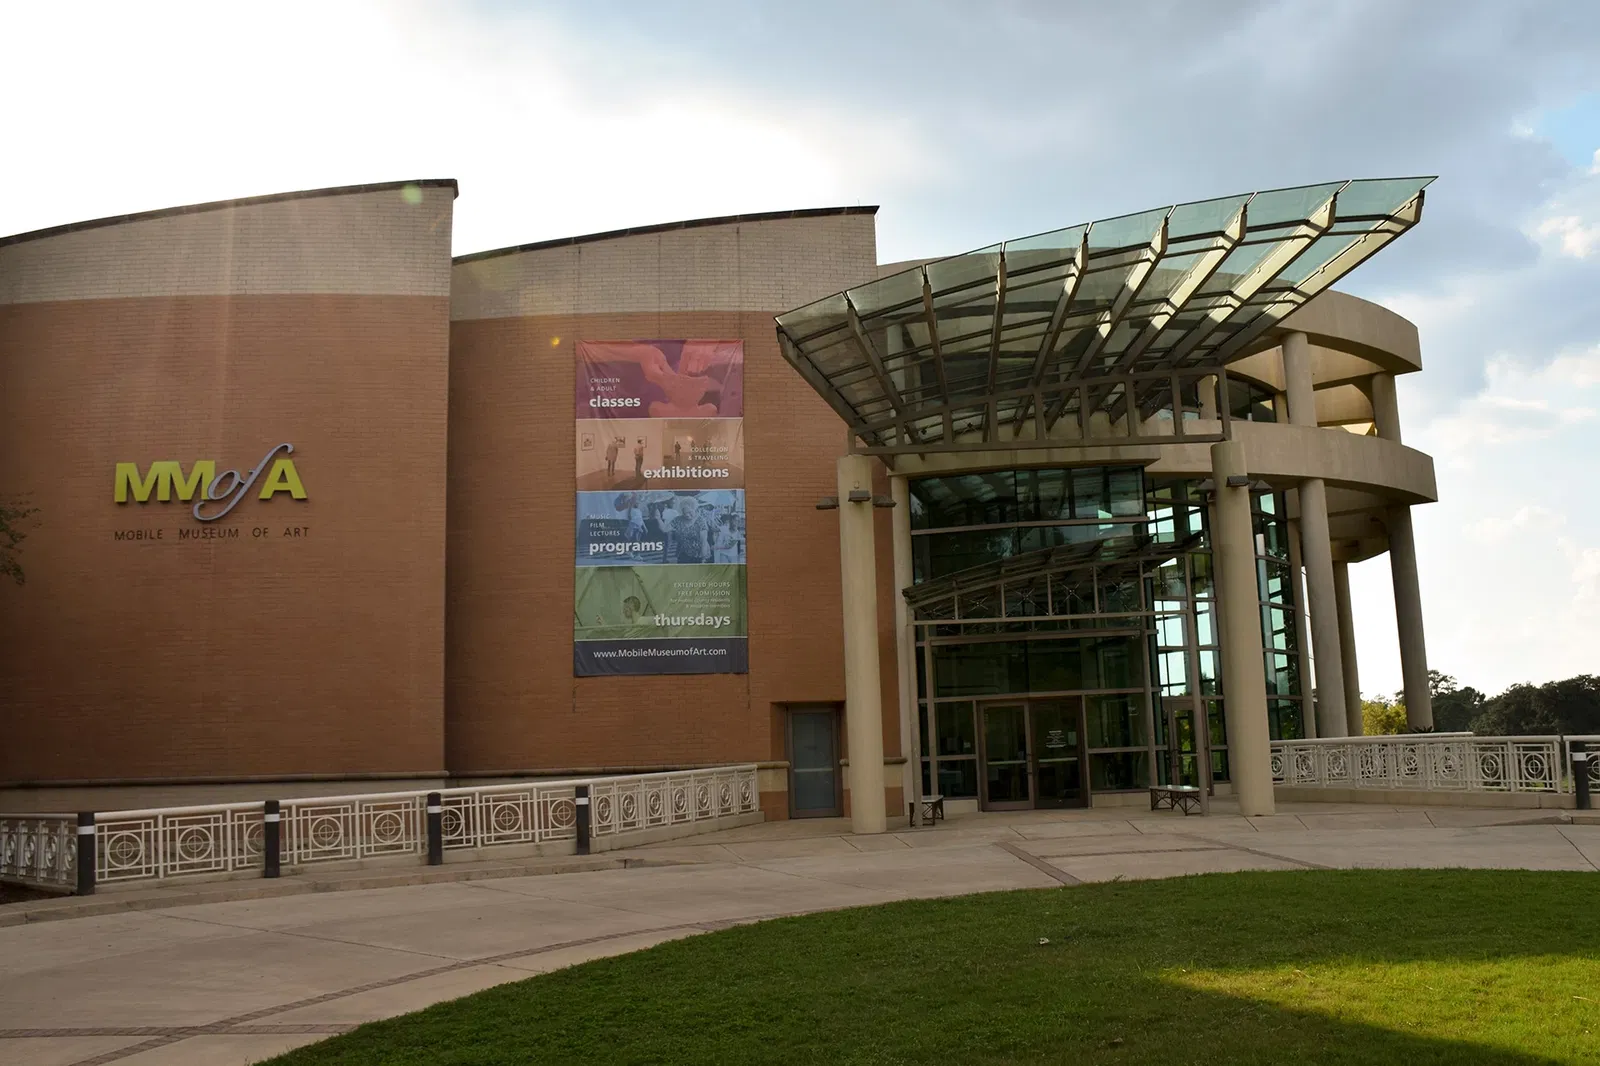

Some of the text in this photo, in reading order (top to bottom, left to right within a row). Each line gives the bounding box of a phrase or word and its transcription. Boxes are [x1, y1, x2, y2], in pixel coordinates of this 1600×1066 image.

[589, 395, 641, 408] classes
[643, 466, 729, 479] exhibitions
[114, 527, 310, 541] MOBILE MUSEUM OF ART
[589, 541, 664, 555] programs
[654, 613, 731, 629] thursdays
[593, 646, 727, 659] www.MobileMuseumofArt.com
